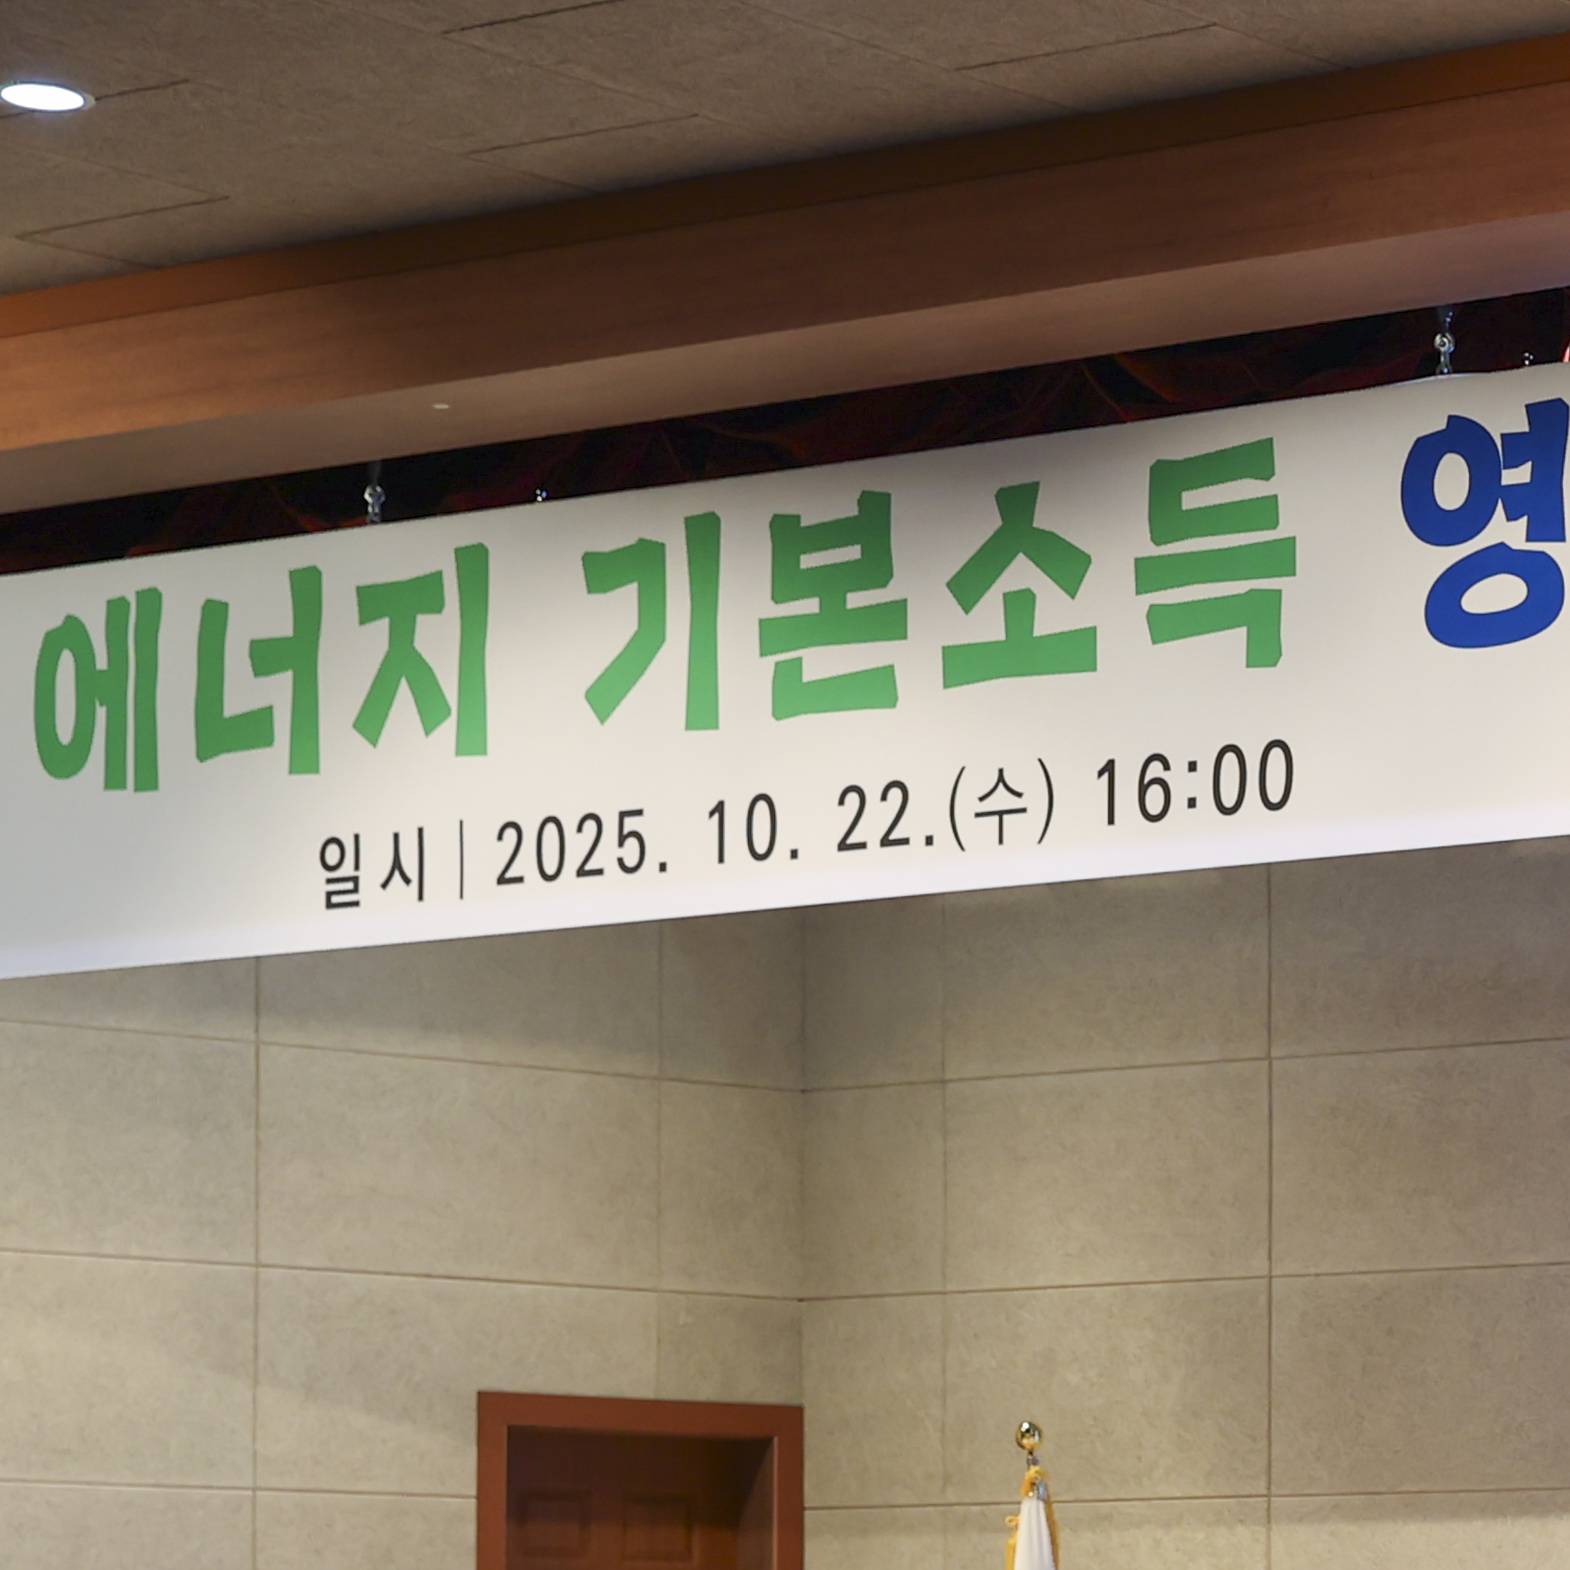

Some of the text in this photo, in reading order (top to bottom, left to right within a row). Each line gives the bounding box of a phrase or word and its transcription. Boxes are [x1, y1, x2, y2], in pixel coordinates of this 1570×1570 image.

[32, 541, 490, 793] 에너지
[581, 436, 1297, 732] 기본소득
[317, 826, 427, 911] 일시
[495, 807, 669, 887] 2025.
[706, 792, 800, 865] 10.
[1096, 738, 1295, 827] 16:00
